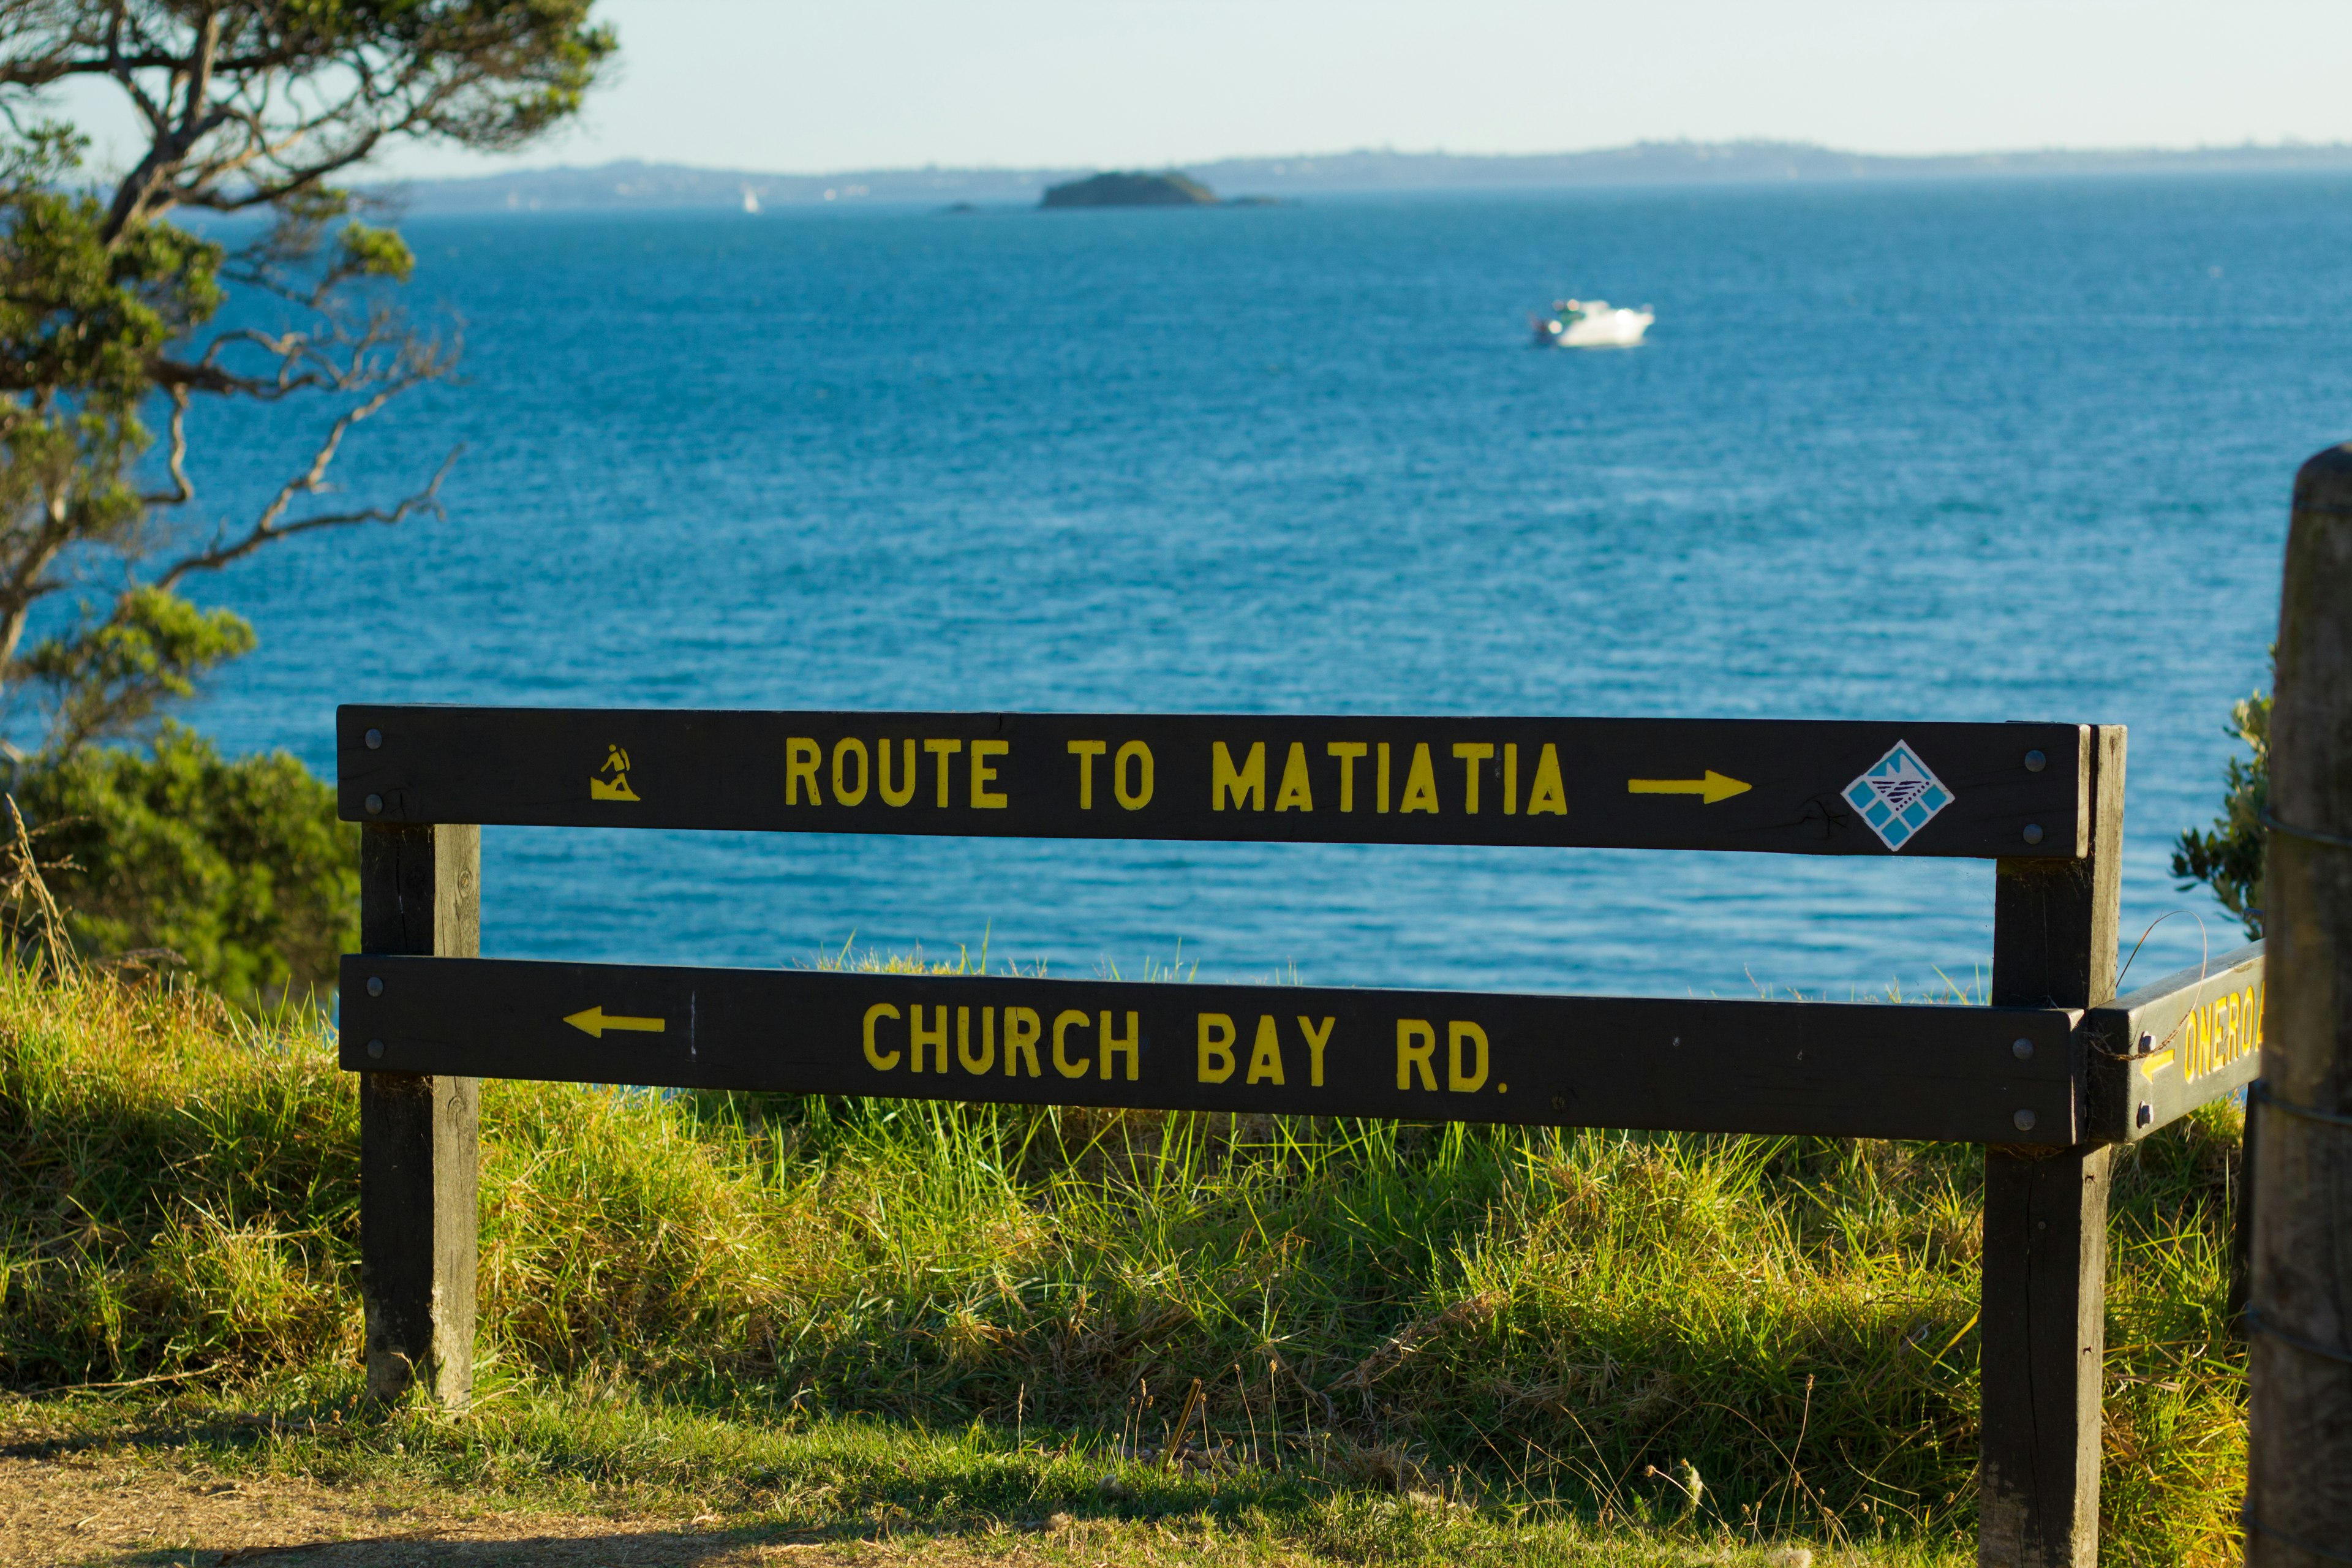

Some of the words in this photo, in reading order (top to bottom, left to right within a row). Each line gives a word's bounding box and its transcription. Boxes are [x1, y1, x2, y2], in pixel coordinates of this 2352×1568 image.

[785, 737, 1009, 809] ROUTE
[1067, 739, 1155, 810] TO
[1212, 741, 1568, 815] MATIATIA
[863, 1003, 1139, 1080] CHURCH
[1197, 1013, 1336, 1087] BAY
[1396, 1019, 1507, 1093] RD.
